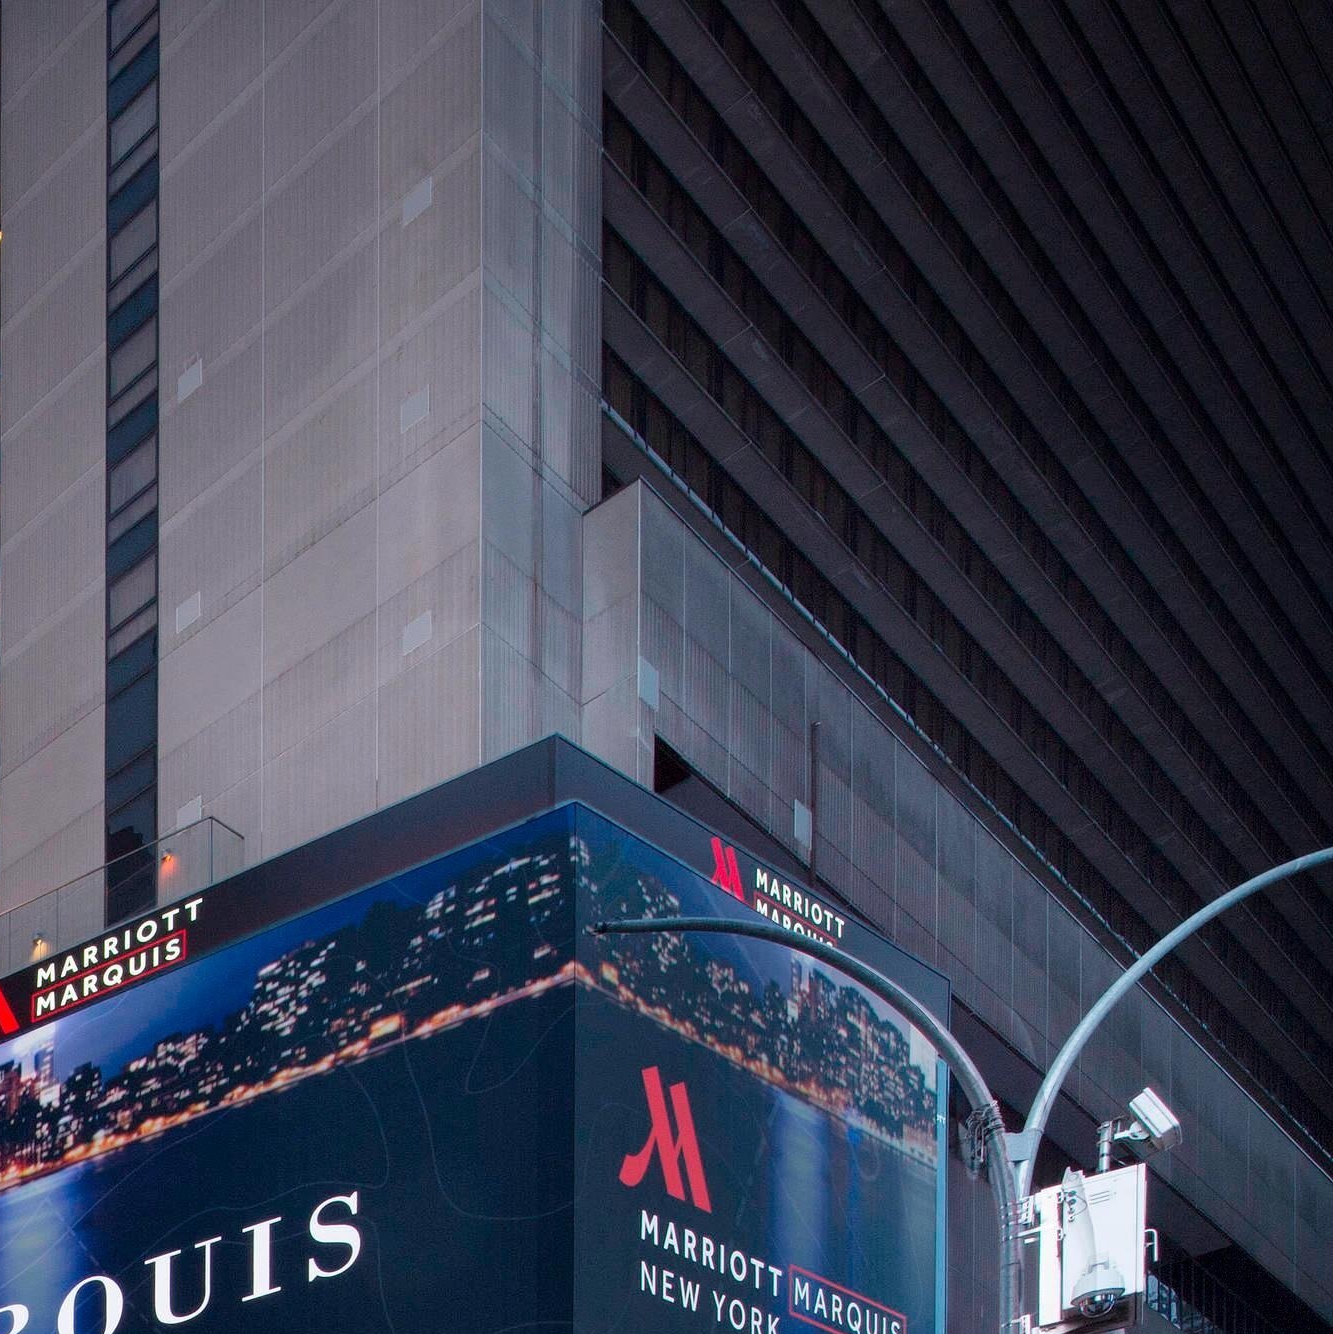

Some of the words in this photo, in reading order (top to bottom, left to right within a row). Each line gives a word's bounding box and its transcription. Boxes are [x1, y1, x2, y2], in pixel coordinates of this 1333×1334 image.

[37, 899, 203, 988] MARRIOTT
[756, 868, 845, 938] MARRIOTT
[35, 936, 182, 1018] MARQUIS
[640, 1210, 783, 1298] MARRIOTT
[640, 1261, 699, 1313] NEW
